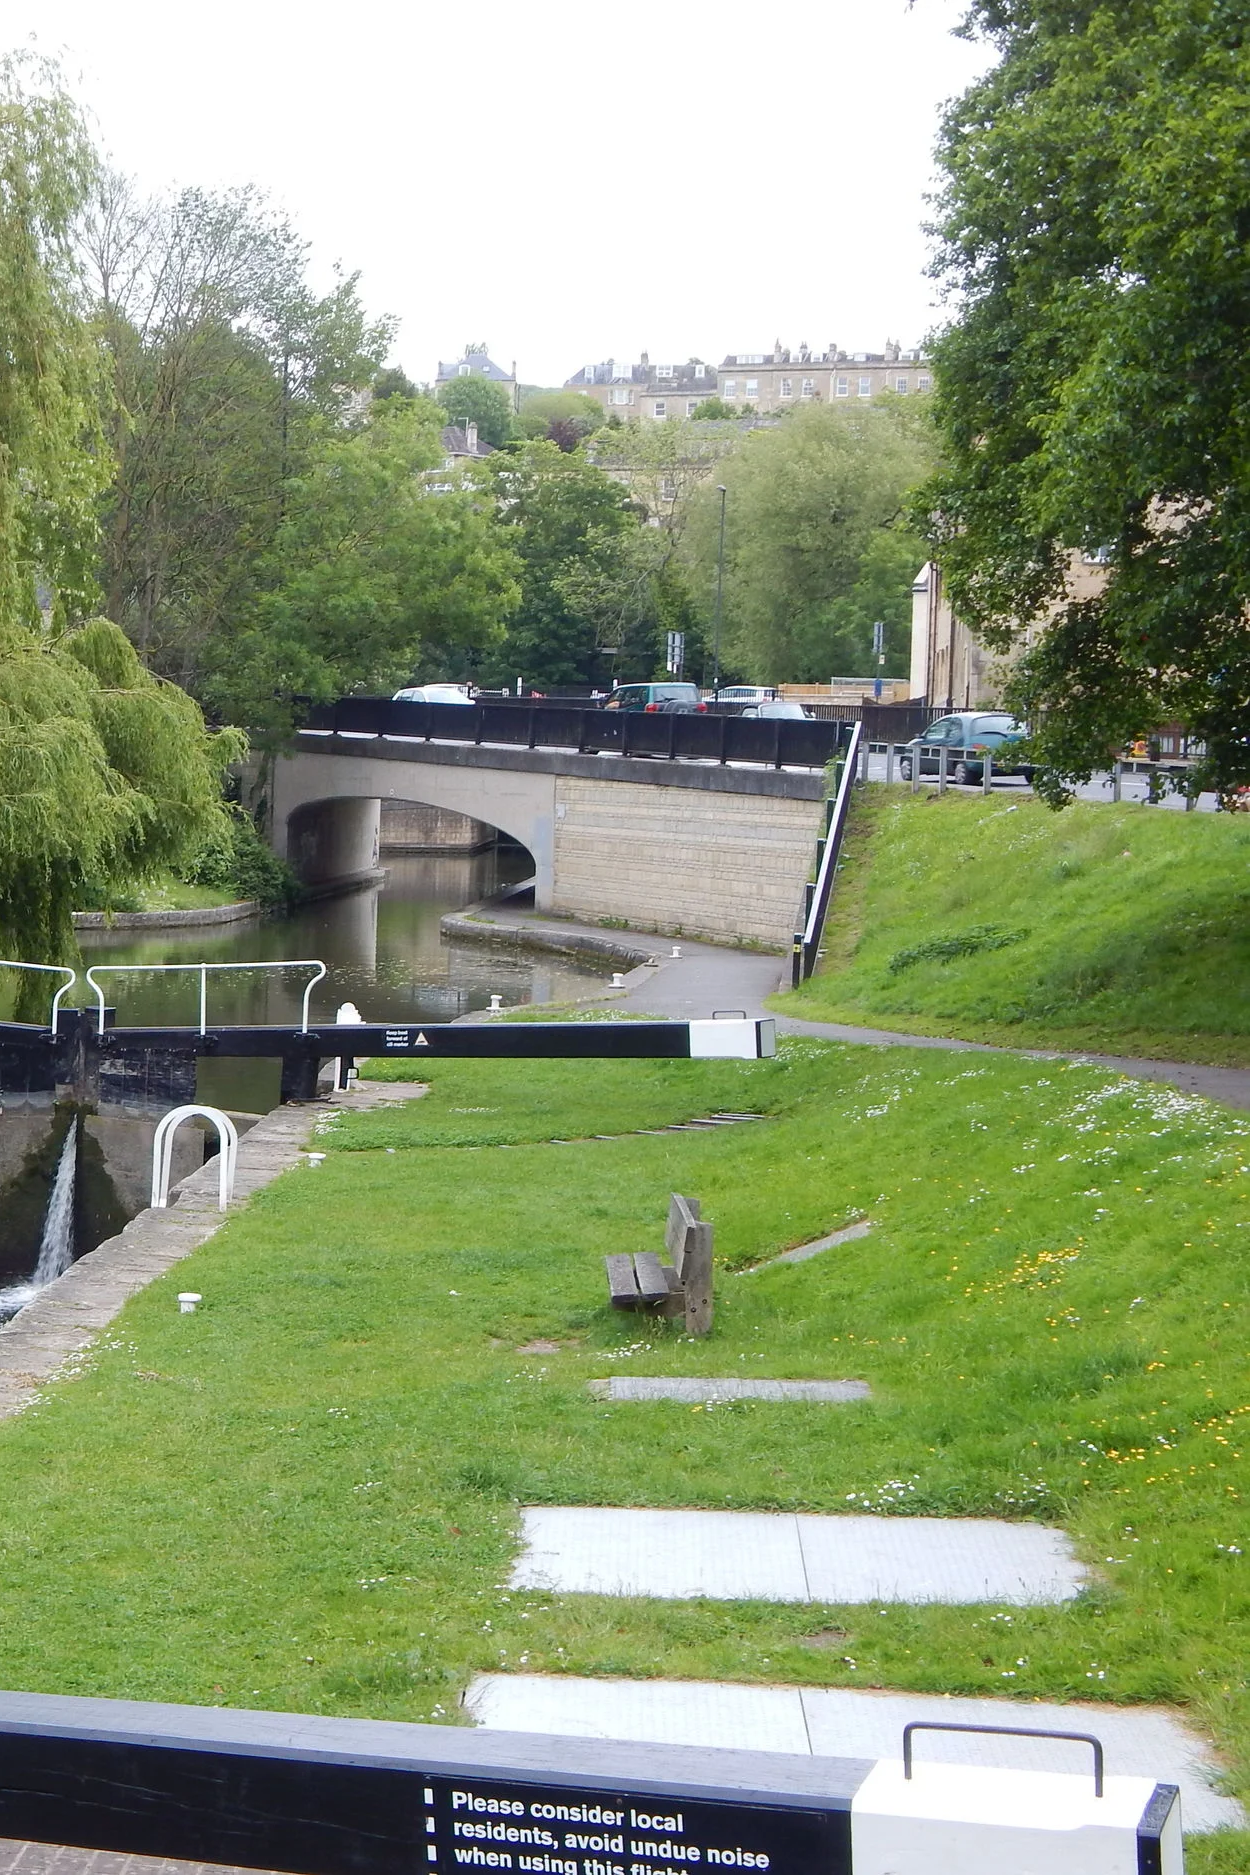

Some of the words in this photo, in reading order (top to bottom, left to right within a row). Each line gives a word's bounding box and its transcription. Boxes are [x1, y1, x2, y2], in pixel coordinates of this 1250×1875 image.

[452, 1791, 524, 1816] Please
[530, 1803, 624, 1826] consider
[630, 1809, 684, 1832] local
[453, 1821, 559, 1849] residents,
[565, 1833, 624, 1853] avoid
[630, 1840, 700, 1861] undue
[707, 1848, 770, 1868] noise
[454, 1847, 512, 1868] when
[519, 1854, 577, 1875] using
[583, 1859, 625, 1875] this
